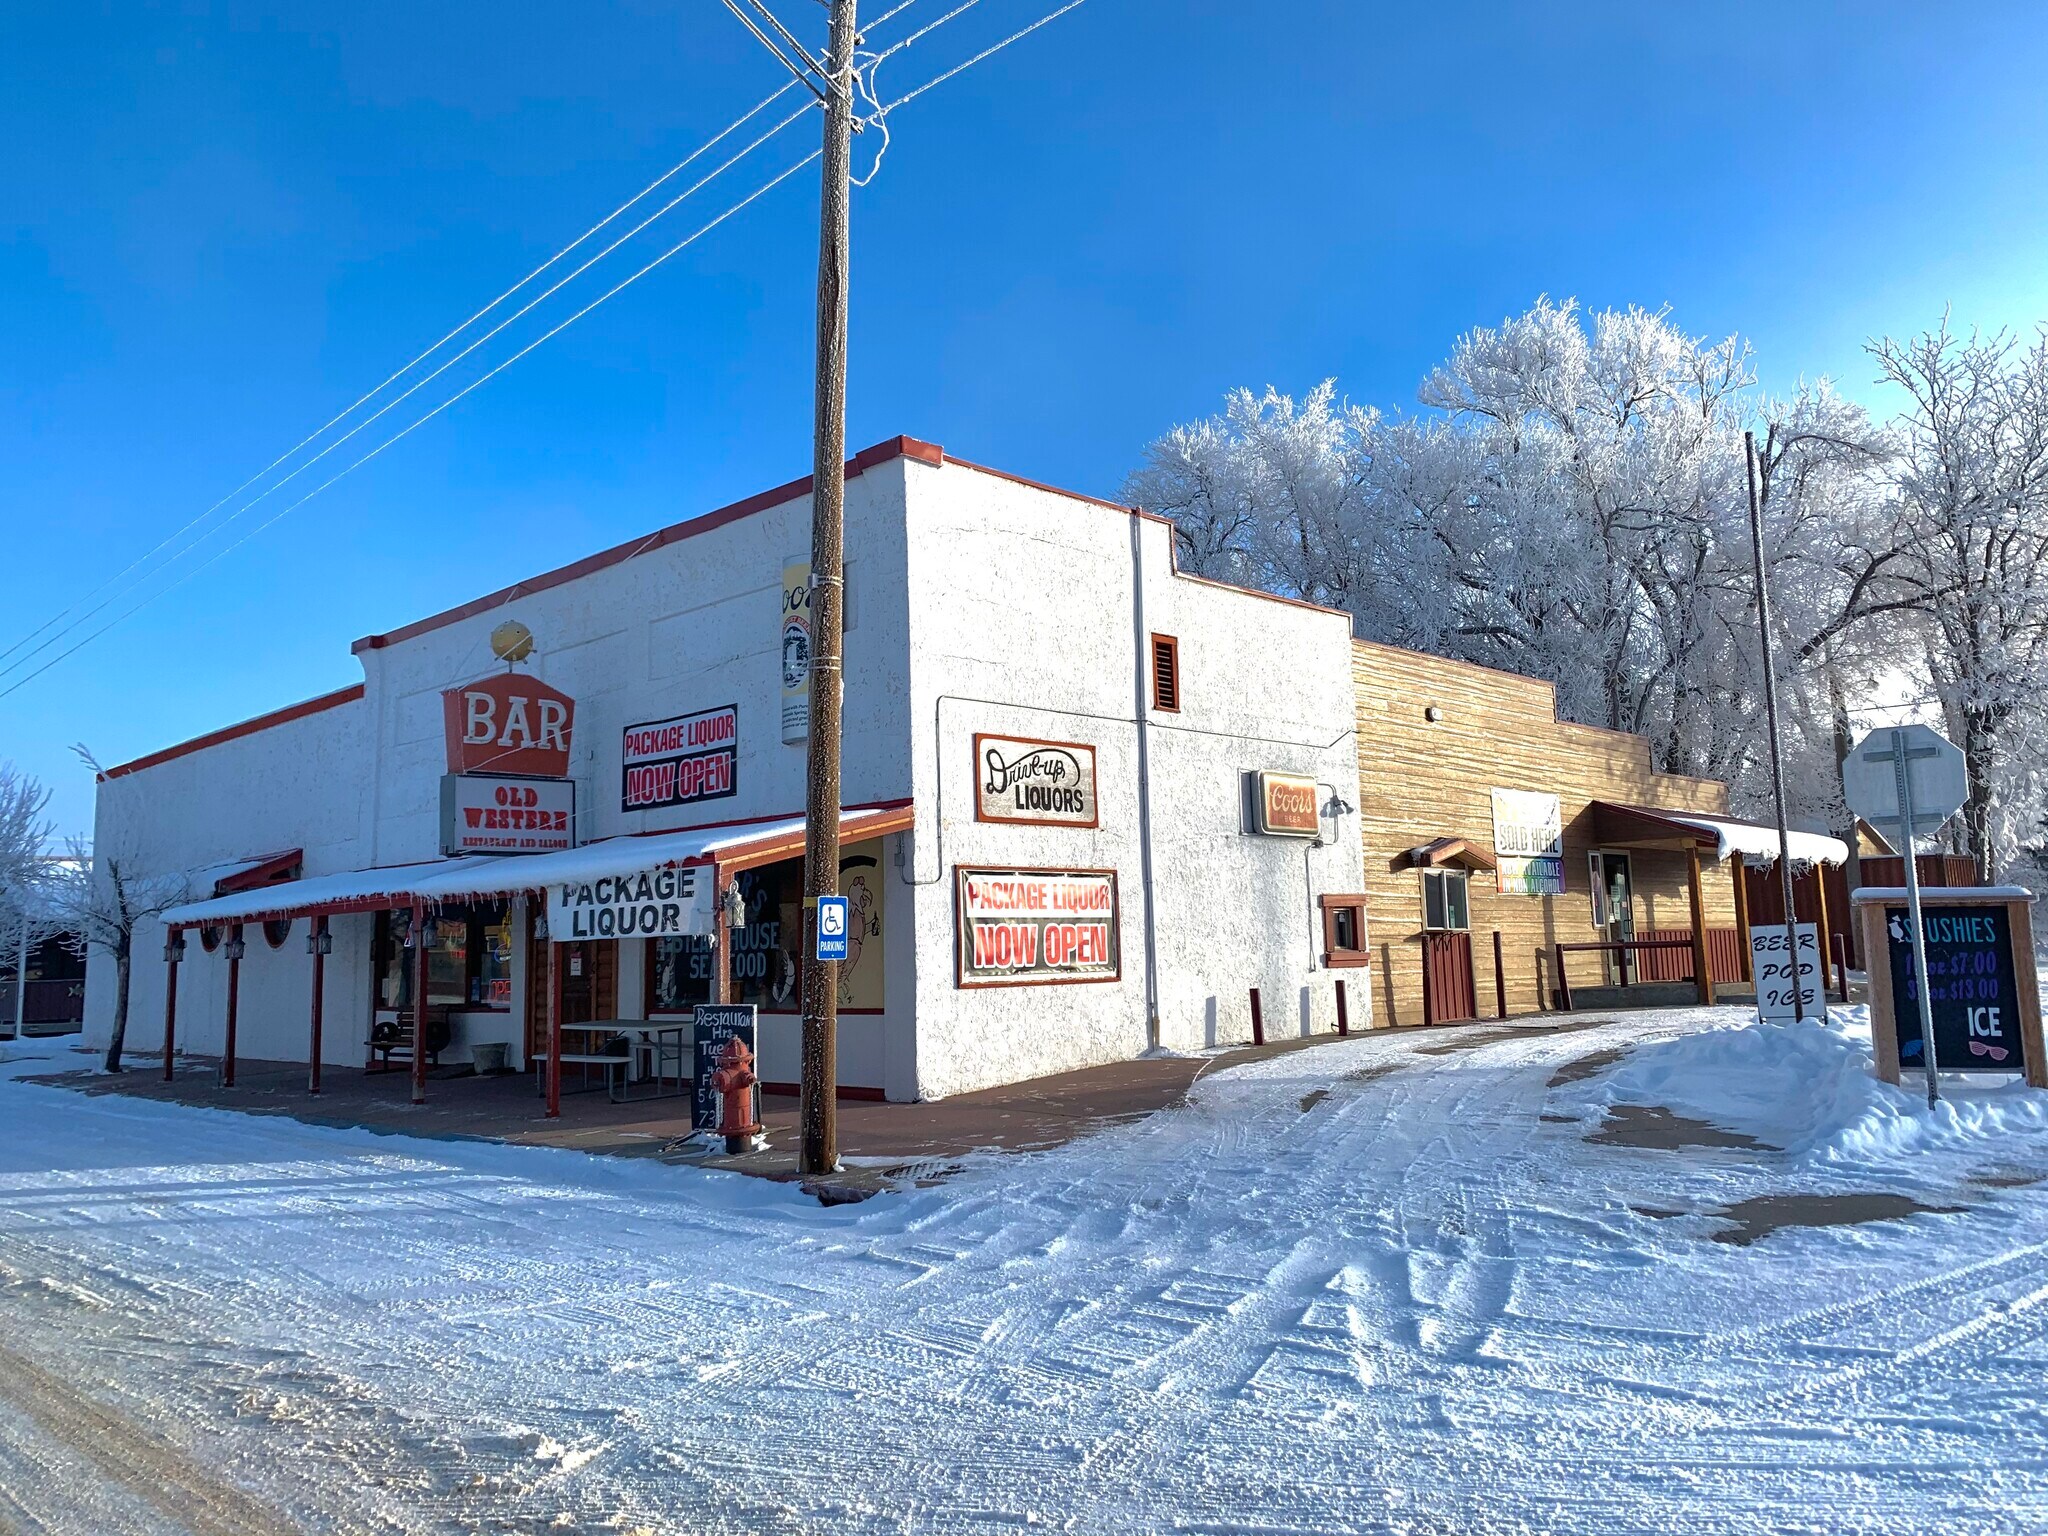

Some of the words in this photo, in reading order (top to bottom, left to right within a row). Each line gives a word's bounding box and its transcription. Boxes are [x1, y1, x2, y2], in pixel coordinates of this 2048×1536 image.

[463, 691, 568, 752] BAR
[626, 725, 684, 758] PACKAGE
[688, 714, 735, 747] LIQUOR
[627, 763, 675, 805] NOW
[679, 752, 731, 798] OPEN
[495, 786, 538, 807] OLD
[1015, 785, 1084, 813] LIQUORS
[1270, 785, 1314, 814] Coors
[463, 807, 568, 831] WESTERN
[463, 837, 517, 848] RESTAURANT
[520, 839, 536, 848] AND
[538, 839, 568, 849] SALOON
[1500, 824, 1529, 851] SOLD
[1531, 827, 1559, 853] HERE
[1523, 861, 1560, 877] AVAILABLE
[562, 869, 696, 908] PACKAGE
[968, 881, 1048, 910] PACKAGE
[1053, 884, 1111, 914] LIQUOR
[1531, 878, 1561, 893] ALCOHOL
[573, 904, 681, 938] LIQUOR
[1903, 917, 1996, 943] SUSHIES
[820, 941, 845, 952] PARKING
[974, 924, 1038, 967] NOW
[1045, 923, 1108, 966] OPEN
[1762, 963, 1813, 981] POP
[1767, 989, 1814, 1007] ICE
[712, 1027, 733, 1039] Hrs
[1967, 1007, 2003, 1037] ICE
